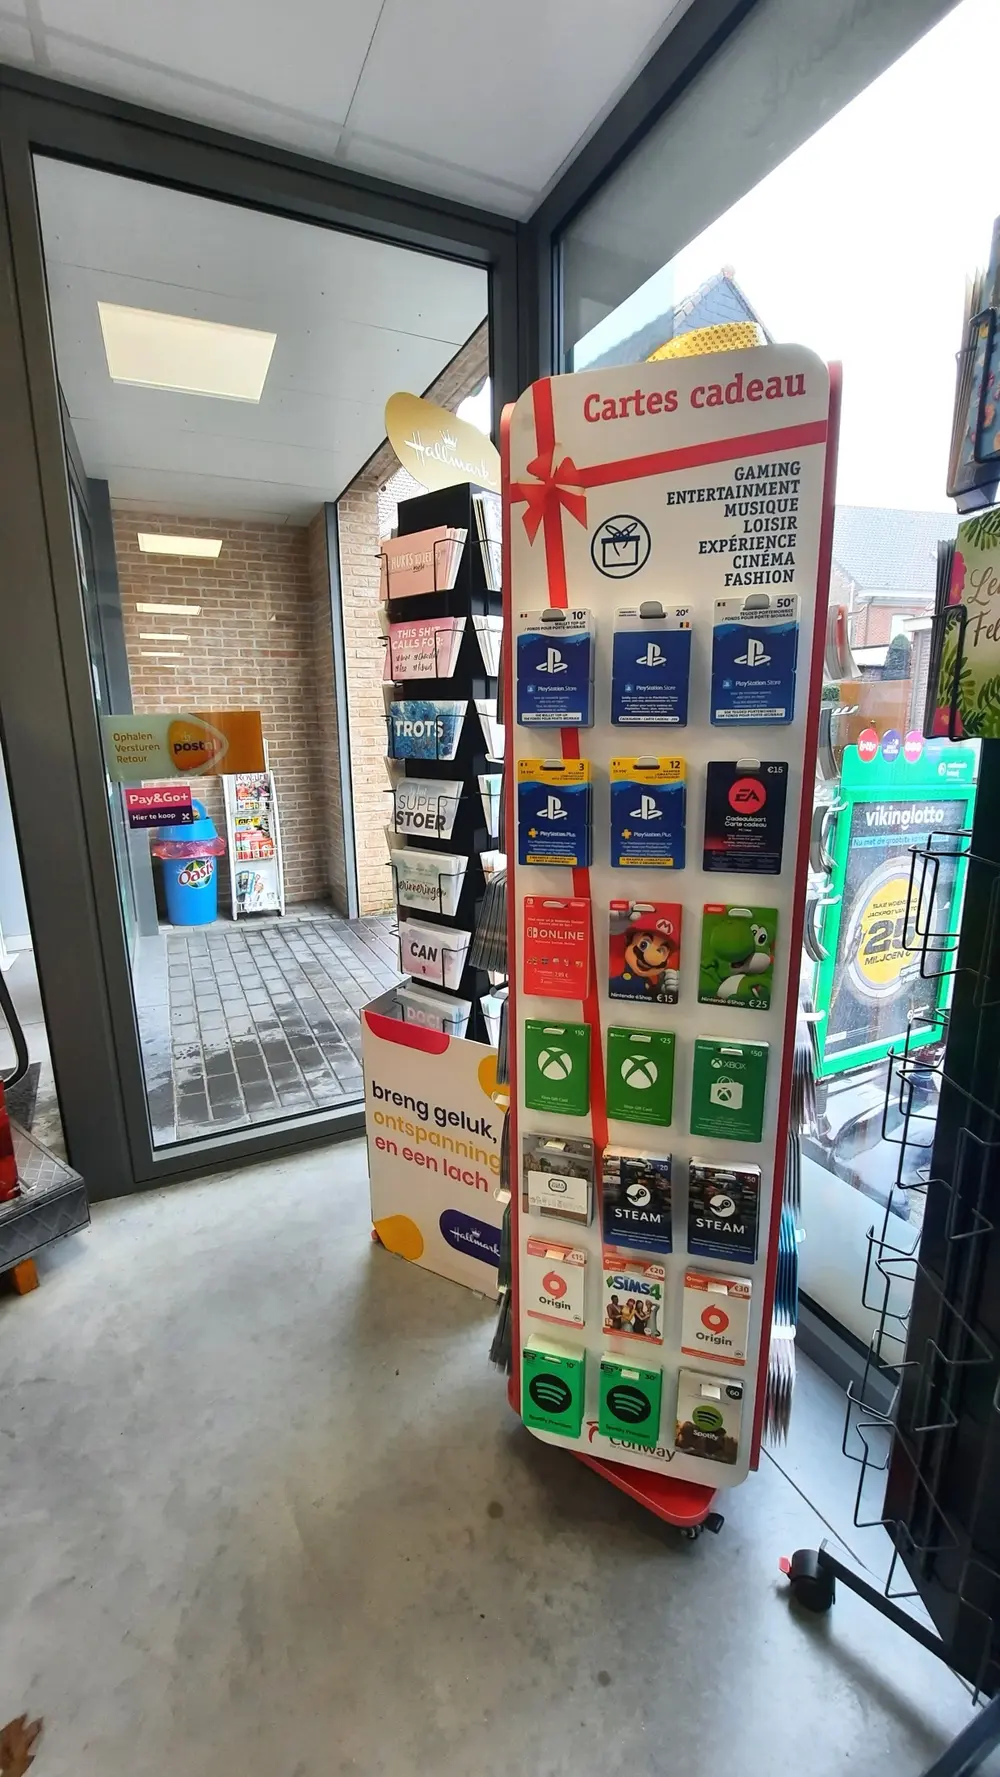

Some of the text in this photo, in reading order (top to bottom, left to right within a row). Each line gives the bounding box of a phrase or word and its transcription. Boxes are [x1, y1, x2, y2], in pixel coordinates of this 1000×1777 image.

[584, 372, 806, 423] Cartes cadeau
[404, 430, 497, 486] Hallmark
[734, 461, 801, 481] GAMING
[666, 479, 800, 505] ENTERTAINMENT
[724, 498, 799, 517] MUSIQUE
[743, 516, 798, 533] LOISIR
[698, 534, 797, 554] EXPÉRIENCE
[733, 549, 795, 569] CINÉMA
[724, 569, 795, 587] FASHION
[967, 566, 1000, 606] Le
[397, 628, 417, 639] THIS
[392, 638, 420, 650] CALLS
[113, 732, 153, 742] Ophalen
[395, 720, 444, 738] TROTS
[114, 743, 161, 752] Versturen
[116, 755, 148, 763] Retour
[579, 763, 584, 771] 3
[129, 792, 189, 805] Pay&Go+
[735, 788, 760, 802] EA
[398, 794, 448, 814] SUPER
[132, 813, 148, 821] Hier
[158, 812, 176, 820] koop
[395, 811, 446, 831] STOER
[866, 804, 945, 830] vikinglotto
[179, 859, 214, 884] Oasis
[539, 929, 584, 940] ONLINE
[863, 916, 916, 955] 25
[410, 942, 437, 962] CAN
[865, 951, 904, 965] MILJOEN
[656, 994, 663, 1002] €
[664, 994, 673, 1002] 15
[749, 999, 755, 1007] €
[723, 1061, 746, 1069] XBOX
[372, 1080, 497, 1144] breng geluk,
[373, 1111, 501, 1176] ontspanning
[375, 1136, 488, 1193] en een lach
[615, 1208, 661, 1223] STEAM
[695, 1218, 745, 1234] STEAM
[450, 1226, 500, 1257] Hallmark
[649, 1283, 661, 1300] 4
[538, 1296, 571, 1310] Origin
[695, 1332, 733, 1346] Origin
[692, 1428, 719, 1441] Spotify
